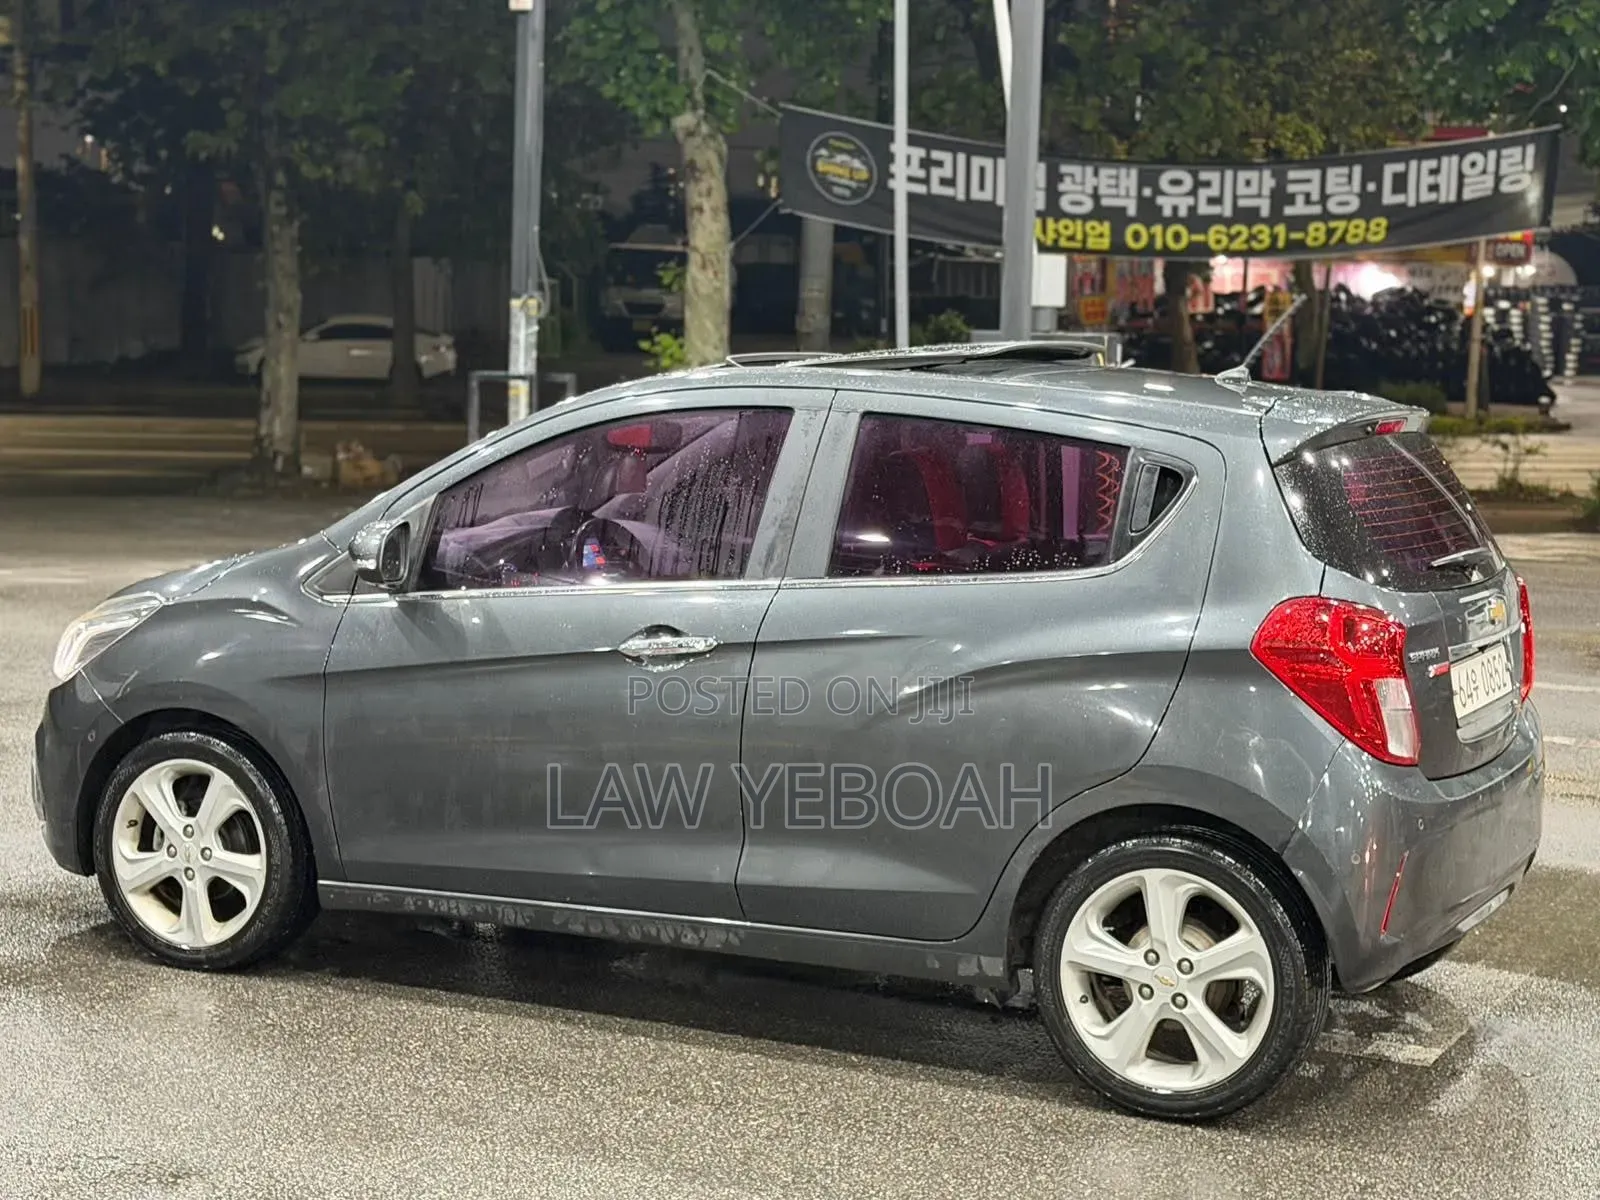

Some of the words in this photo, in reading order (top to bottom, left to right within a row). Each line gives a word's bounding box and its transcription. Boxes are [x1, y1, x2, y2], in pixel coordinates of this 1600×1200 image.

[888, 143, 1046, 211] 프리미
[1283, 143, 1536, 217] 코팅·디테일링
[1123, 215, 1389, 252] 010-6231-8788
